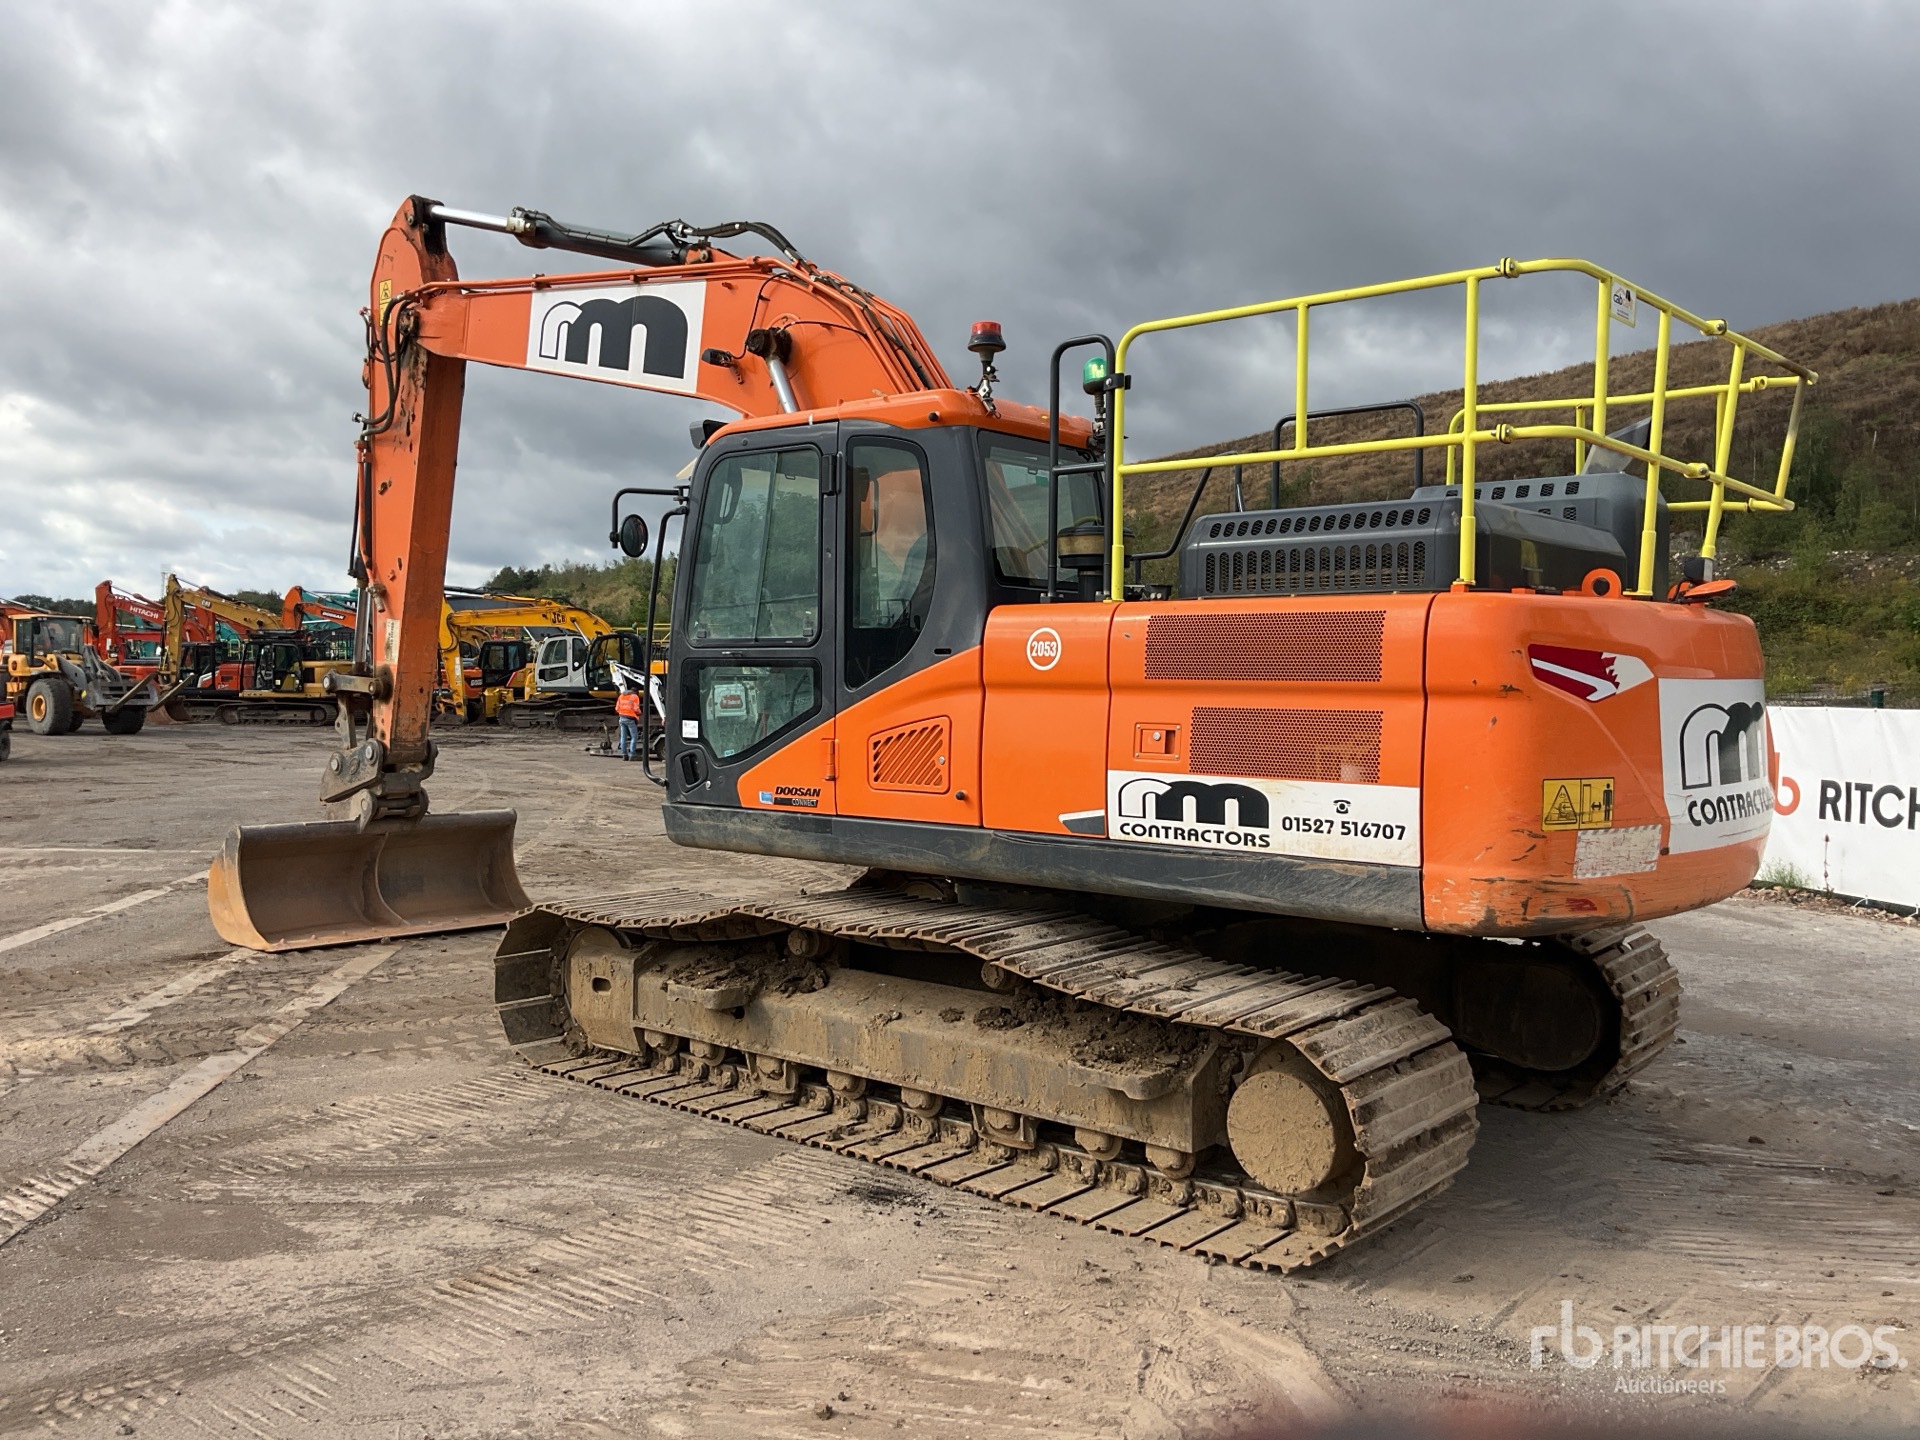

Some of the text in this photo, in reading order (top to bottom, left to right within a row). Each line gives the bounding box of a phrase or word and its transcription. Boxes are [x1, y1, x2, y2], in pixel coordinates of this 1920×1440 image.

[130, 606, 159, 619] HITACHI
[551, 612, 566, 624] JCB
[1031, 640, 1057, 657] 2053
[775, 786, 821, 797] DOOSAN
[791, 798, 817, 807] CONNECT
[1281, 815, 1406, 841] 01527 516707
[1119, 822, 1271, 848] CONTRACTORS
